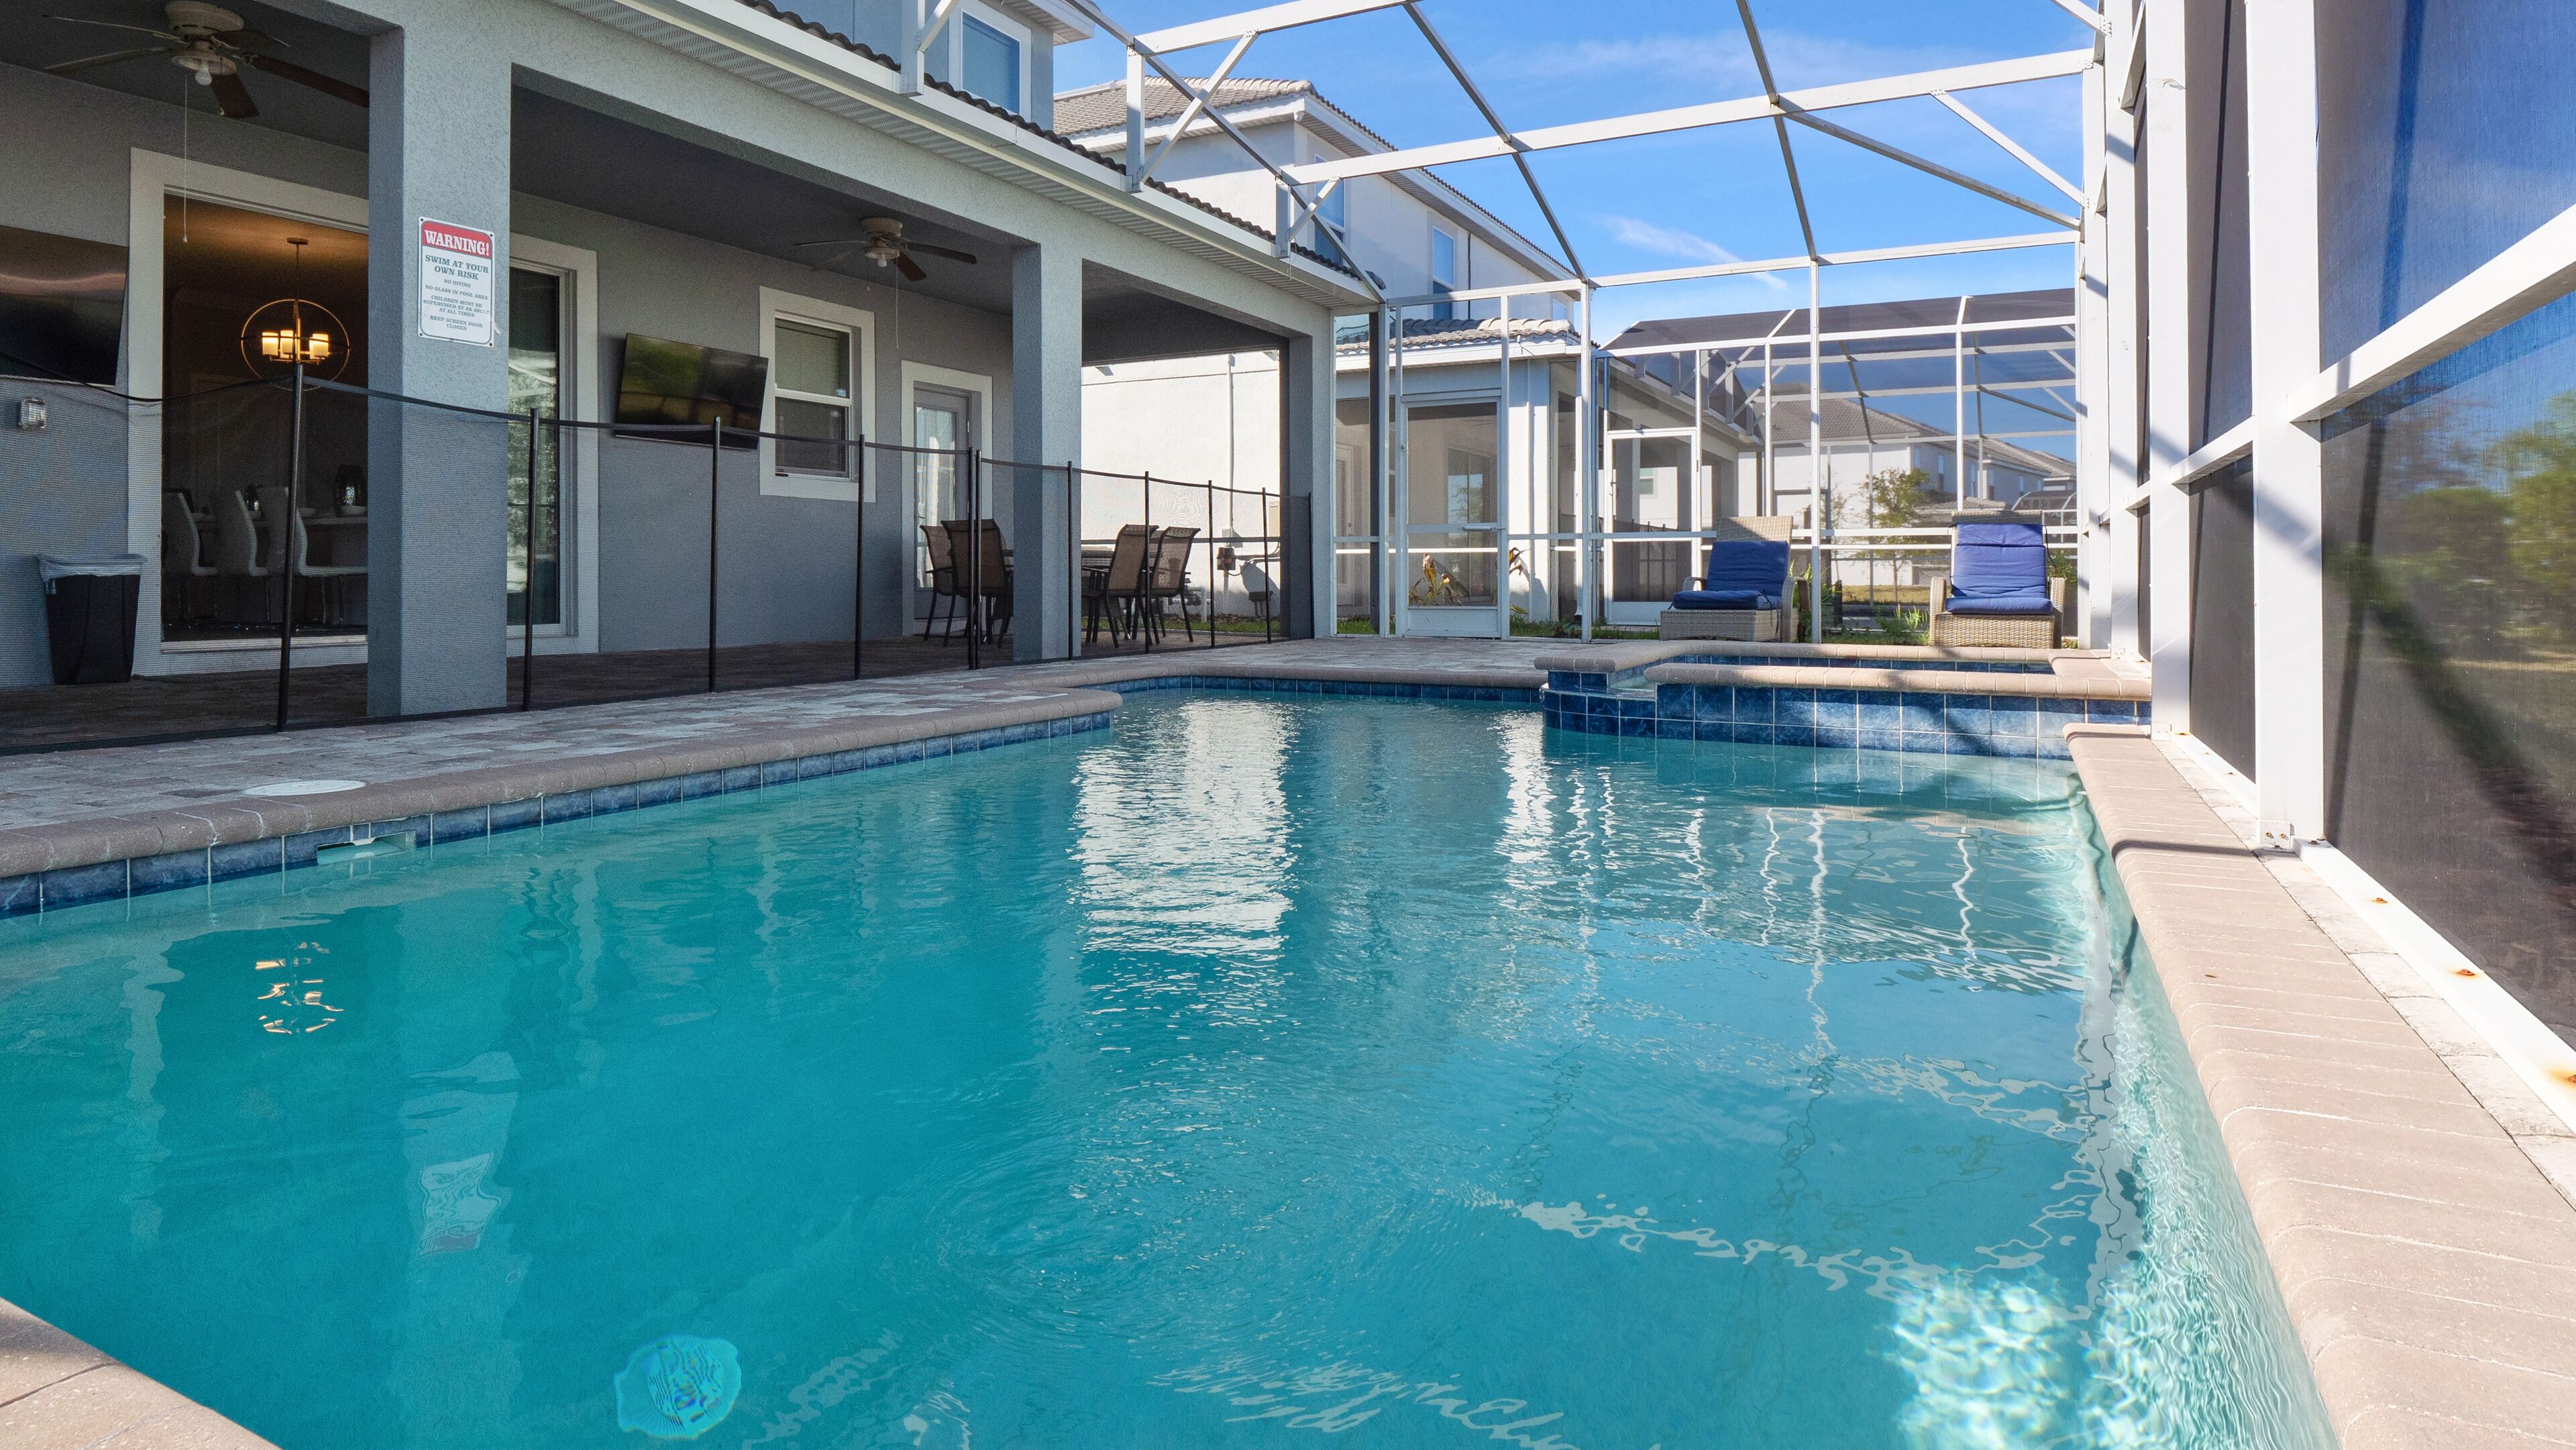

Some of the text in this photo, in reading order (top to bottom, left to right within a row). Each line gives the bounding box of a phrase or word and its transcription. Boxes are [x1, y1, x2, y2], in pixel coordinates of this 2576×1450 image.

[425, 229, 489, 256] WARNING!
[425, 255, 450, 265] SWIM
[466, 264, 489, 273] YOUR
[435, 266, 478, 280] OWN RISK
[423, 300, 456, 309] SUPERVISED
[431, 295, 458, 303] CHILDREN
